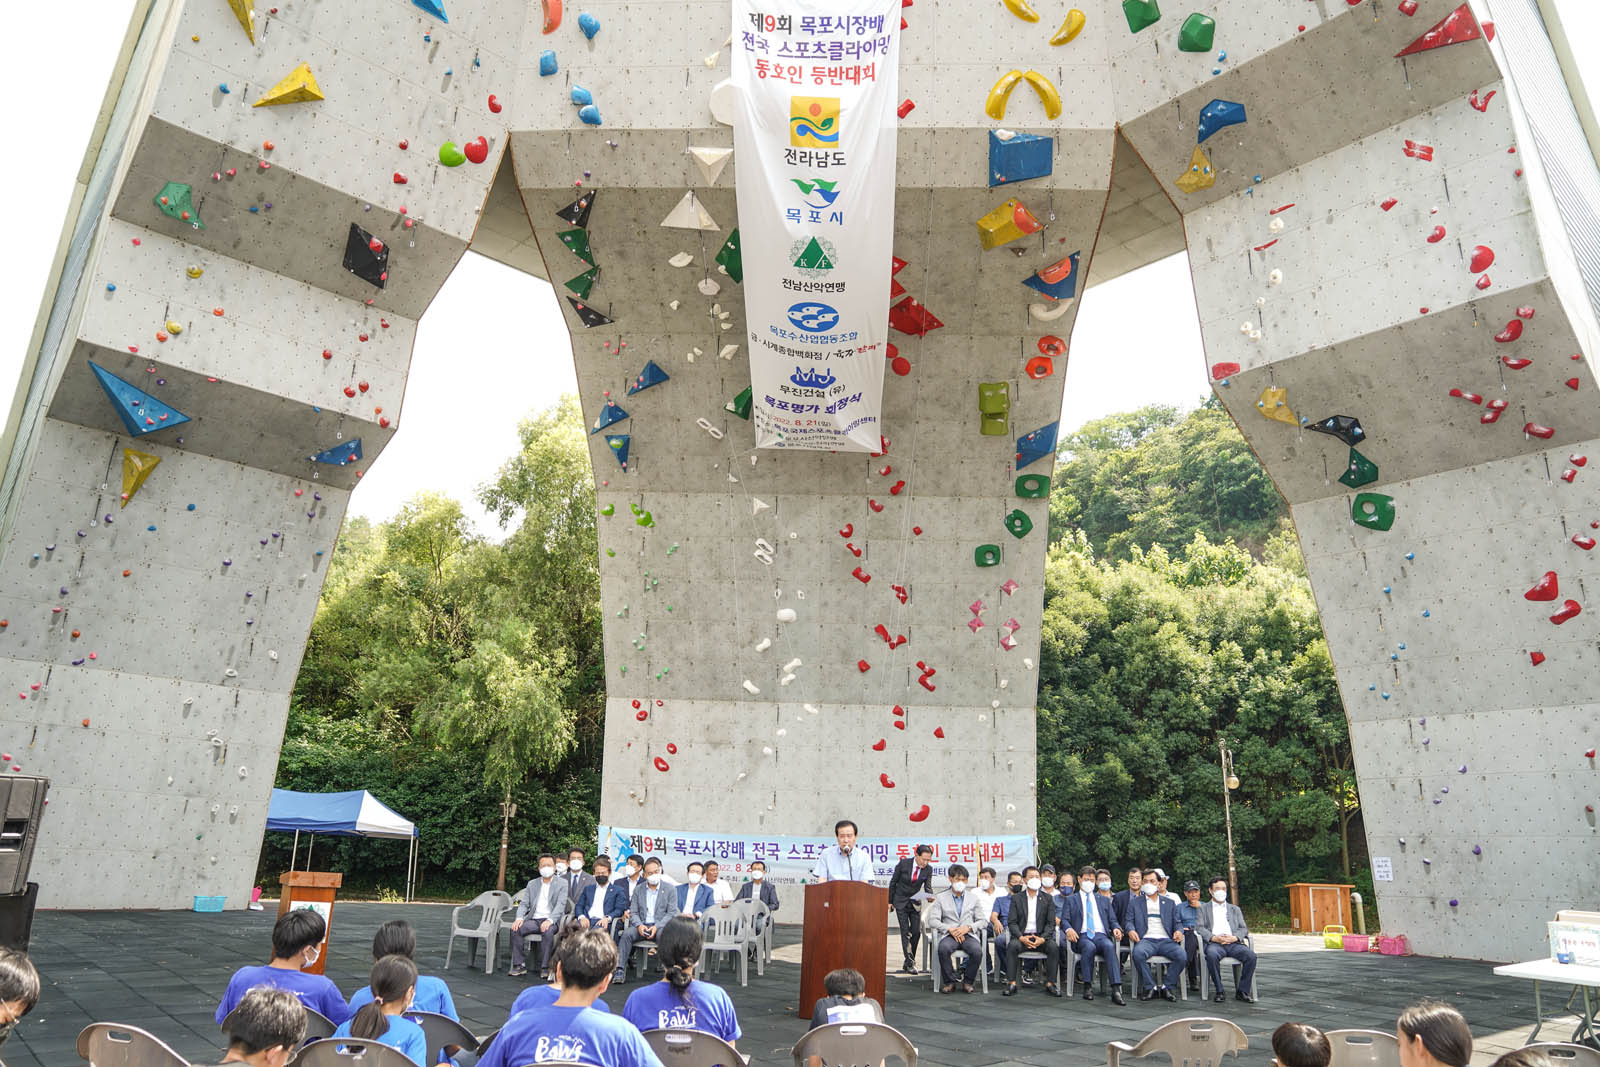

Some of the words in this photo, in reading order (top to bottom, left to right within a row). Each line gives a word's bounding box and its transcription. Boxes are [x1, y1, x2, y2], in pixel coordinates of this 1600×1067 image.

[749, 13, 792, 35] 제9회
[800, 15, 885, 36] 목포시장배
[742, 31, 770, 54] 전국
[777, 35, 891, 61] 스포츠클라이밍
[755, 59, 802, 84] 동호인
[810, 62, 876, 86] 등반대회
[784, 149, 847, 168] 전라남도
[782, 278, 846, 293] 전남산악연맹
[779, 384, 825, 399] 무진건설
[764, 395, 820, 414] 목포명가
[630, 834, 667, 855] 제9회
[673, 839, 745, 861] 목포시장배
[751, 842, 781, 861] 전국
